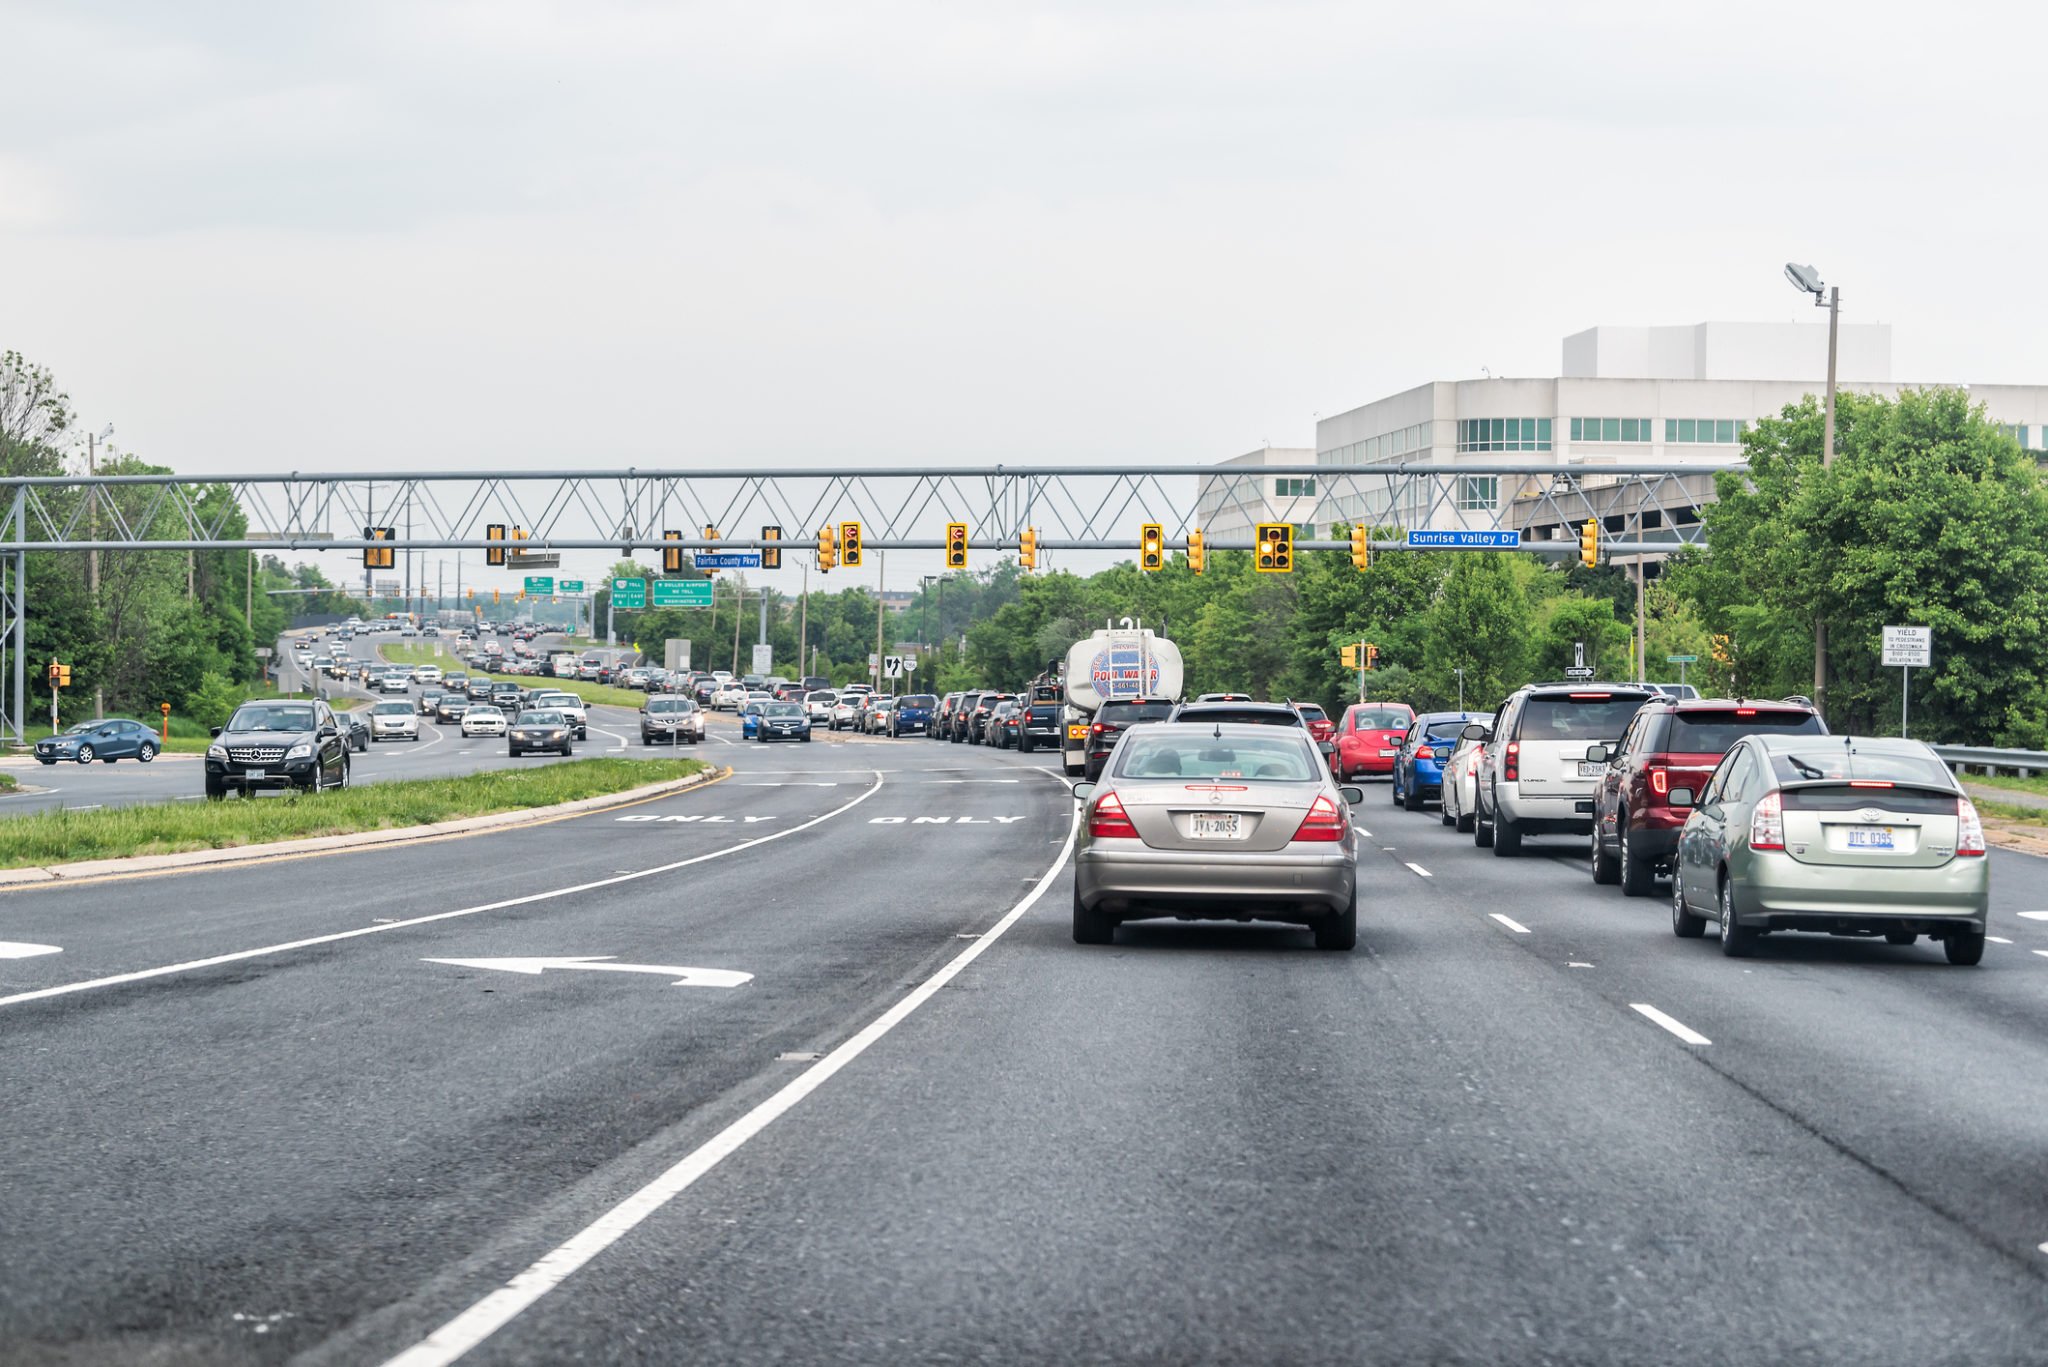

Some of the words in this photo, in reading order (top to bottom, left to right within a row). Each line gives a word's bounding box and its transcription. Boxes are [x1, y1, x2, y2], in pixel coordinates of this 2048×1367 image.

[1412, 533, 1455, 544] Sunrise
[1460, 533, 1496, 546] Valley
[1501, 533, 1514, 544] Dr
[697, 556, 718, 566] Fairfax
[719, 556, 741, 567] County
[742, 556, 759, 567] Pkwy
[614, 814, 777, 823] ONLY
[868, 815, 1027, 824] ONLY
